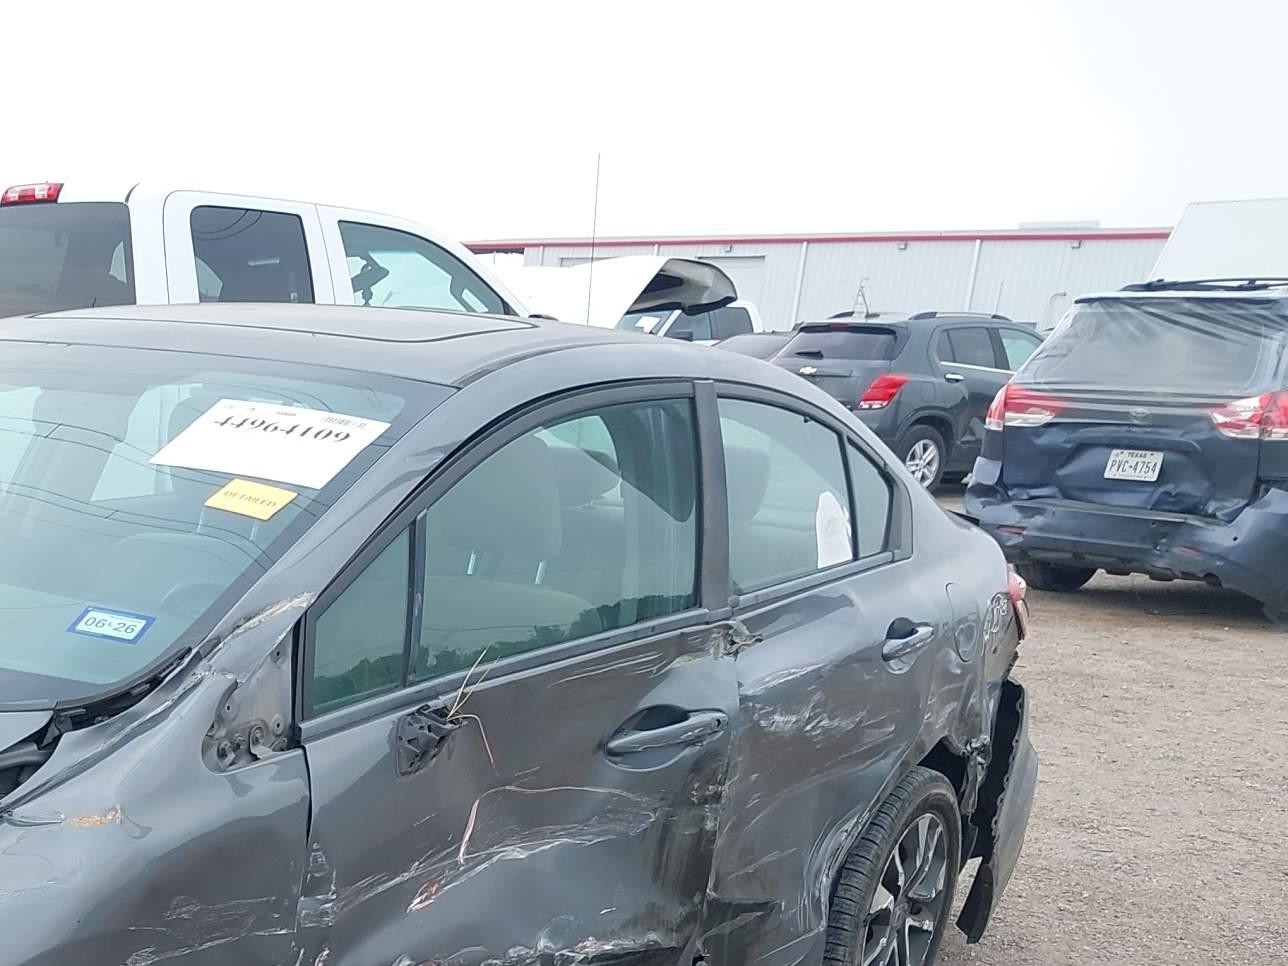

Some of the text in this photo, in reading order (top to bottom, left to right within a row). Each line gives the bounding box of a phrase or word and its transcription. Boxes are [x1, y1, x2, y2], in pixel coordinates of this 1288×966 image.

[213, 415, 351, 443] 44964109
[1127, 451, 1148, 459] TEXAS
[223, 490, 278, 508] DETAILED
